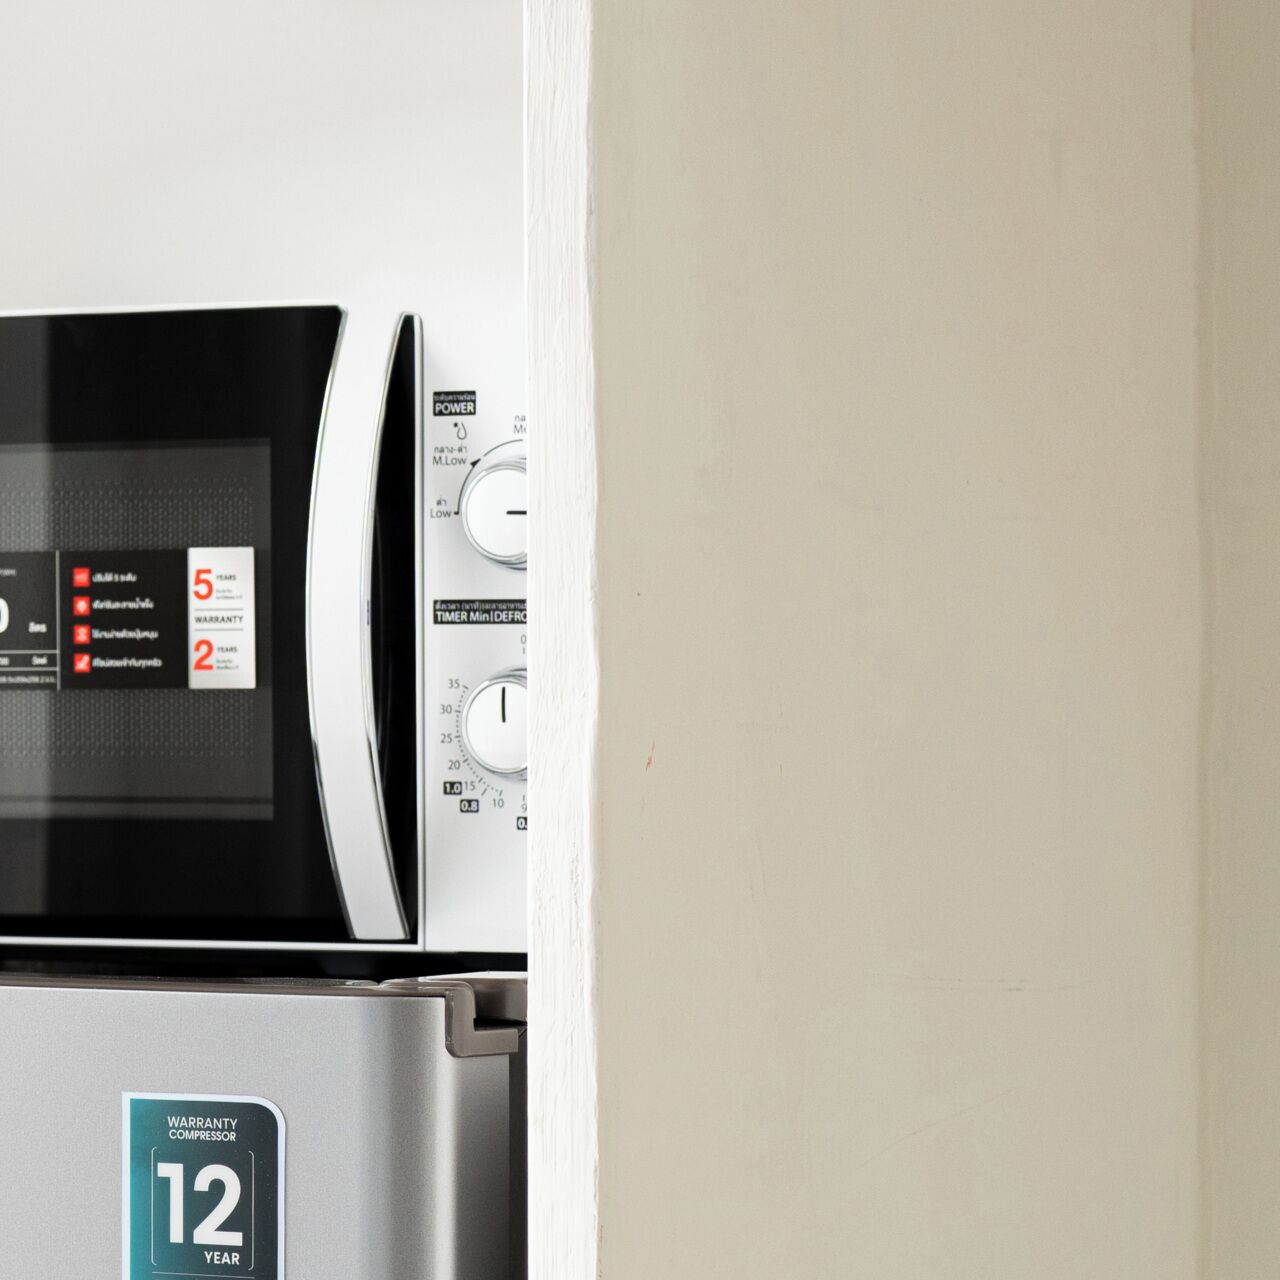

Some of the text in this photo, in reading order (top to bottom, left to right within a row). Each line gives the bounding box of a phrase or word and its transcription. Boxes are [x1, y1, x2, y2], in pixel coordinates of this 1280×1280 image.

[435, 402, 474, 414] POWER
[432, 456, 467, 466] M.Low
[430, 508, 452, 518] Low
[193, 568, 213, 601] 5
[194, 615, 244, 624] WARRANTY
[436, 610, 467, 622] TIMER
[193, 639, 213, 671] 2
[448, 678, 460, 689] 35
[440, 704, 452, 714] 30
[440, 733, 452, 744] 25
[448, 760, 460, 771] 20
[444, 783, 461, 794] 1.0
[464, 781, 475, 791] 15
[461, 800, 478, 811] 0.8
[493, 798, 504, 808] 10
[167, 1116, 238, 1129] WARRANTY
[169, 1129, 236, 1142] COMPRESSOR
[157, 1162, 243, 1247] 12
[204, 1251, 240, 1265] YEAR
